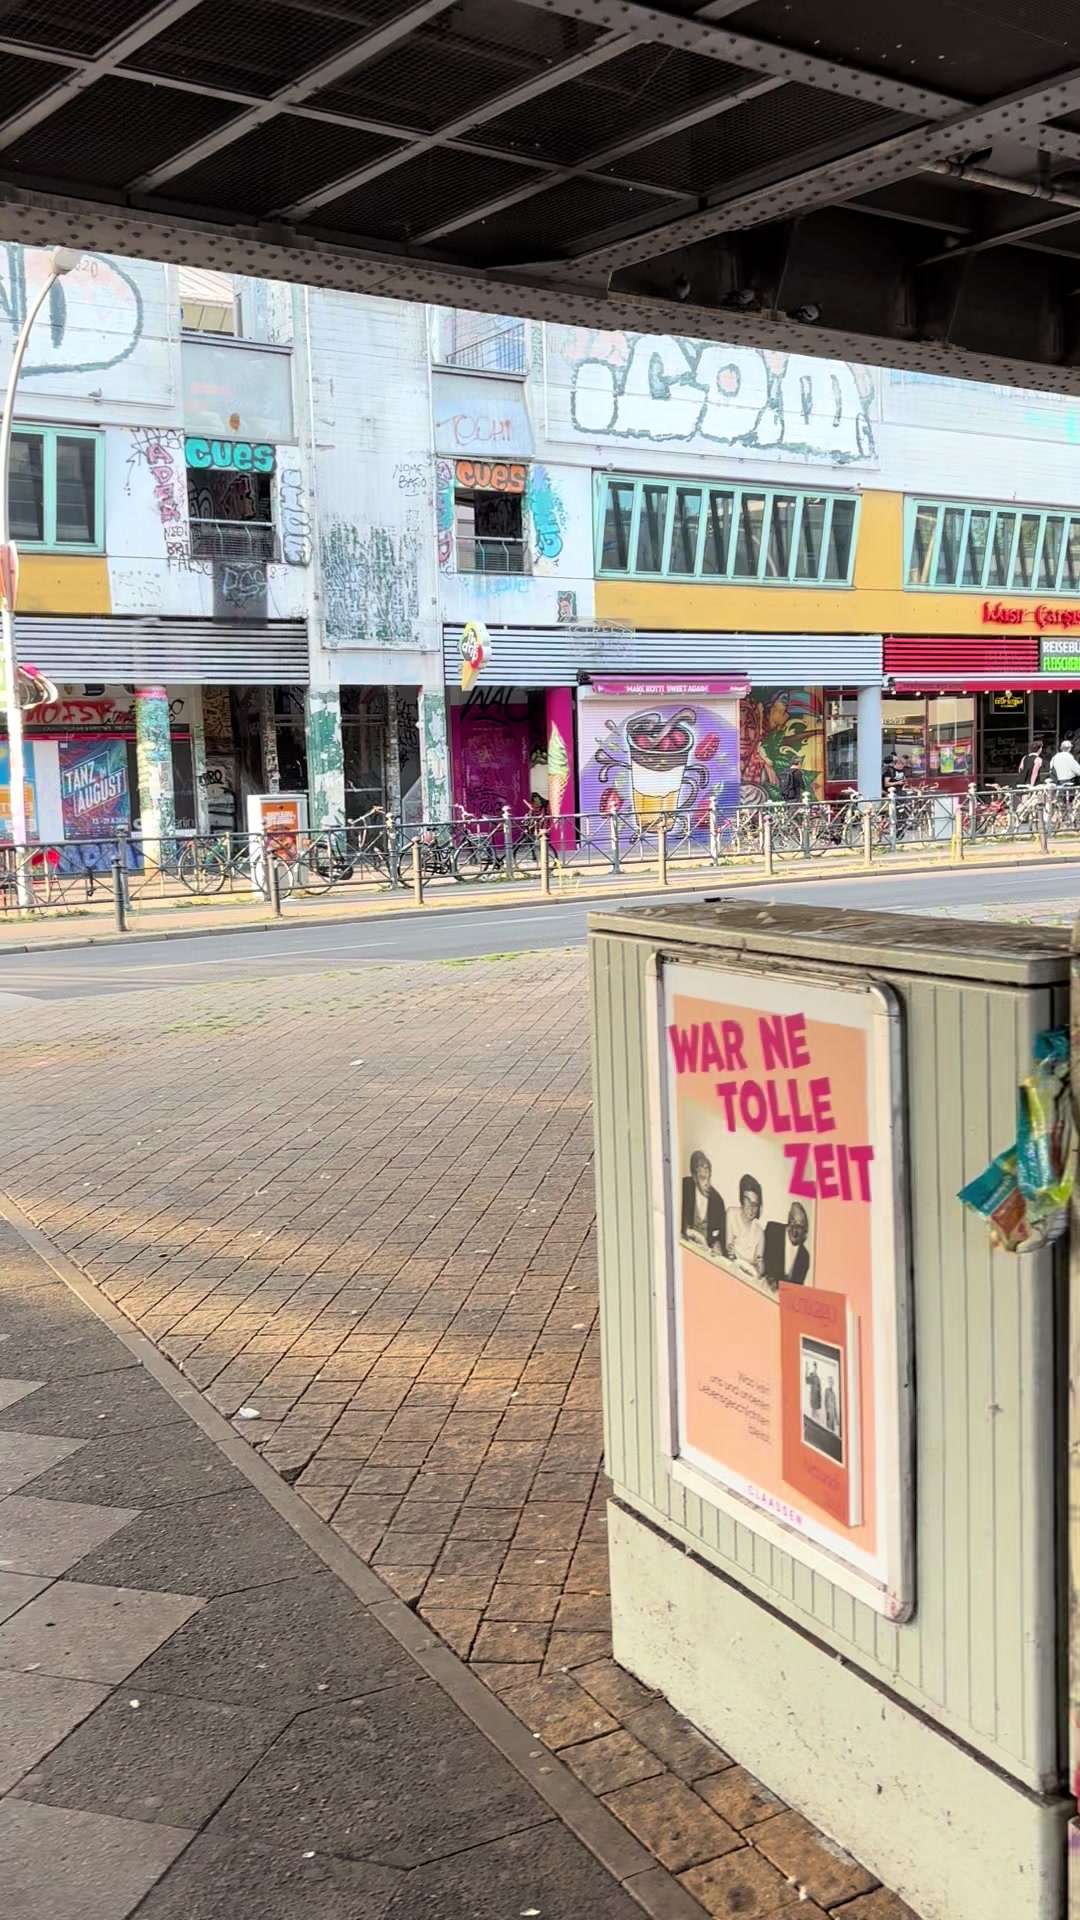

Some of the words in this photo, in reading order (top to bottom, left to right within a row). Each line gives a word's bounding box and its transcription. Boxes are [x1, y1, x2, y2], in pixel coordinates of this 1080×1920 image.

[65, 761, 96, 793] TANZ
[78, 772, 122, 812] AUGUST
[669, 1020, 748, 1074] WAR
[758, 1013, 811, 1071] NE
[716, 1077, 836, 1134] TOLLE
[784, 1143, 874, 1202] ZEIT
